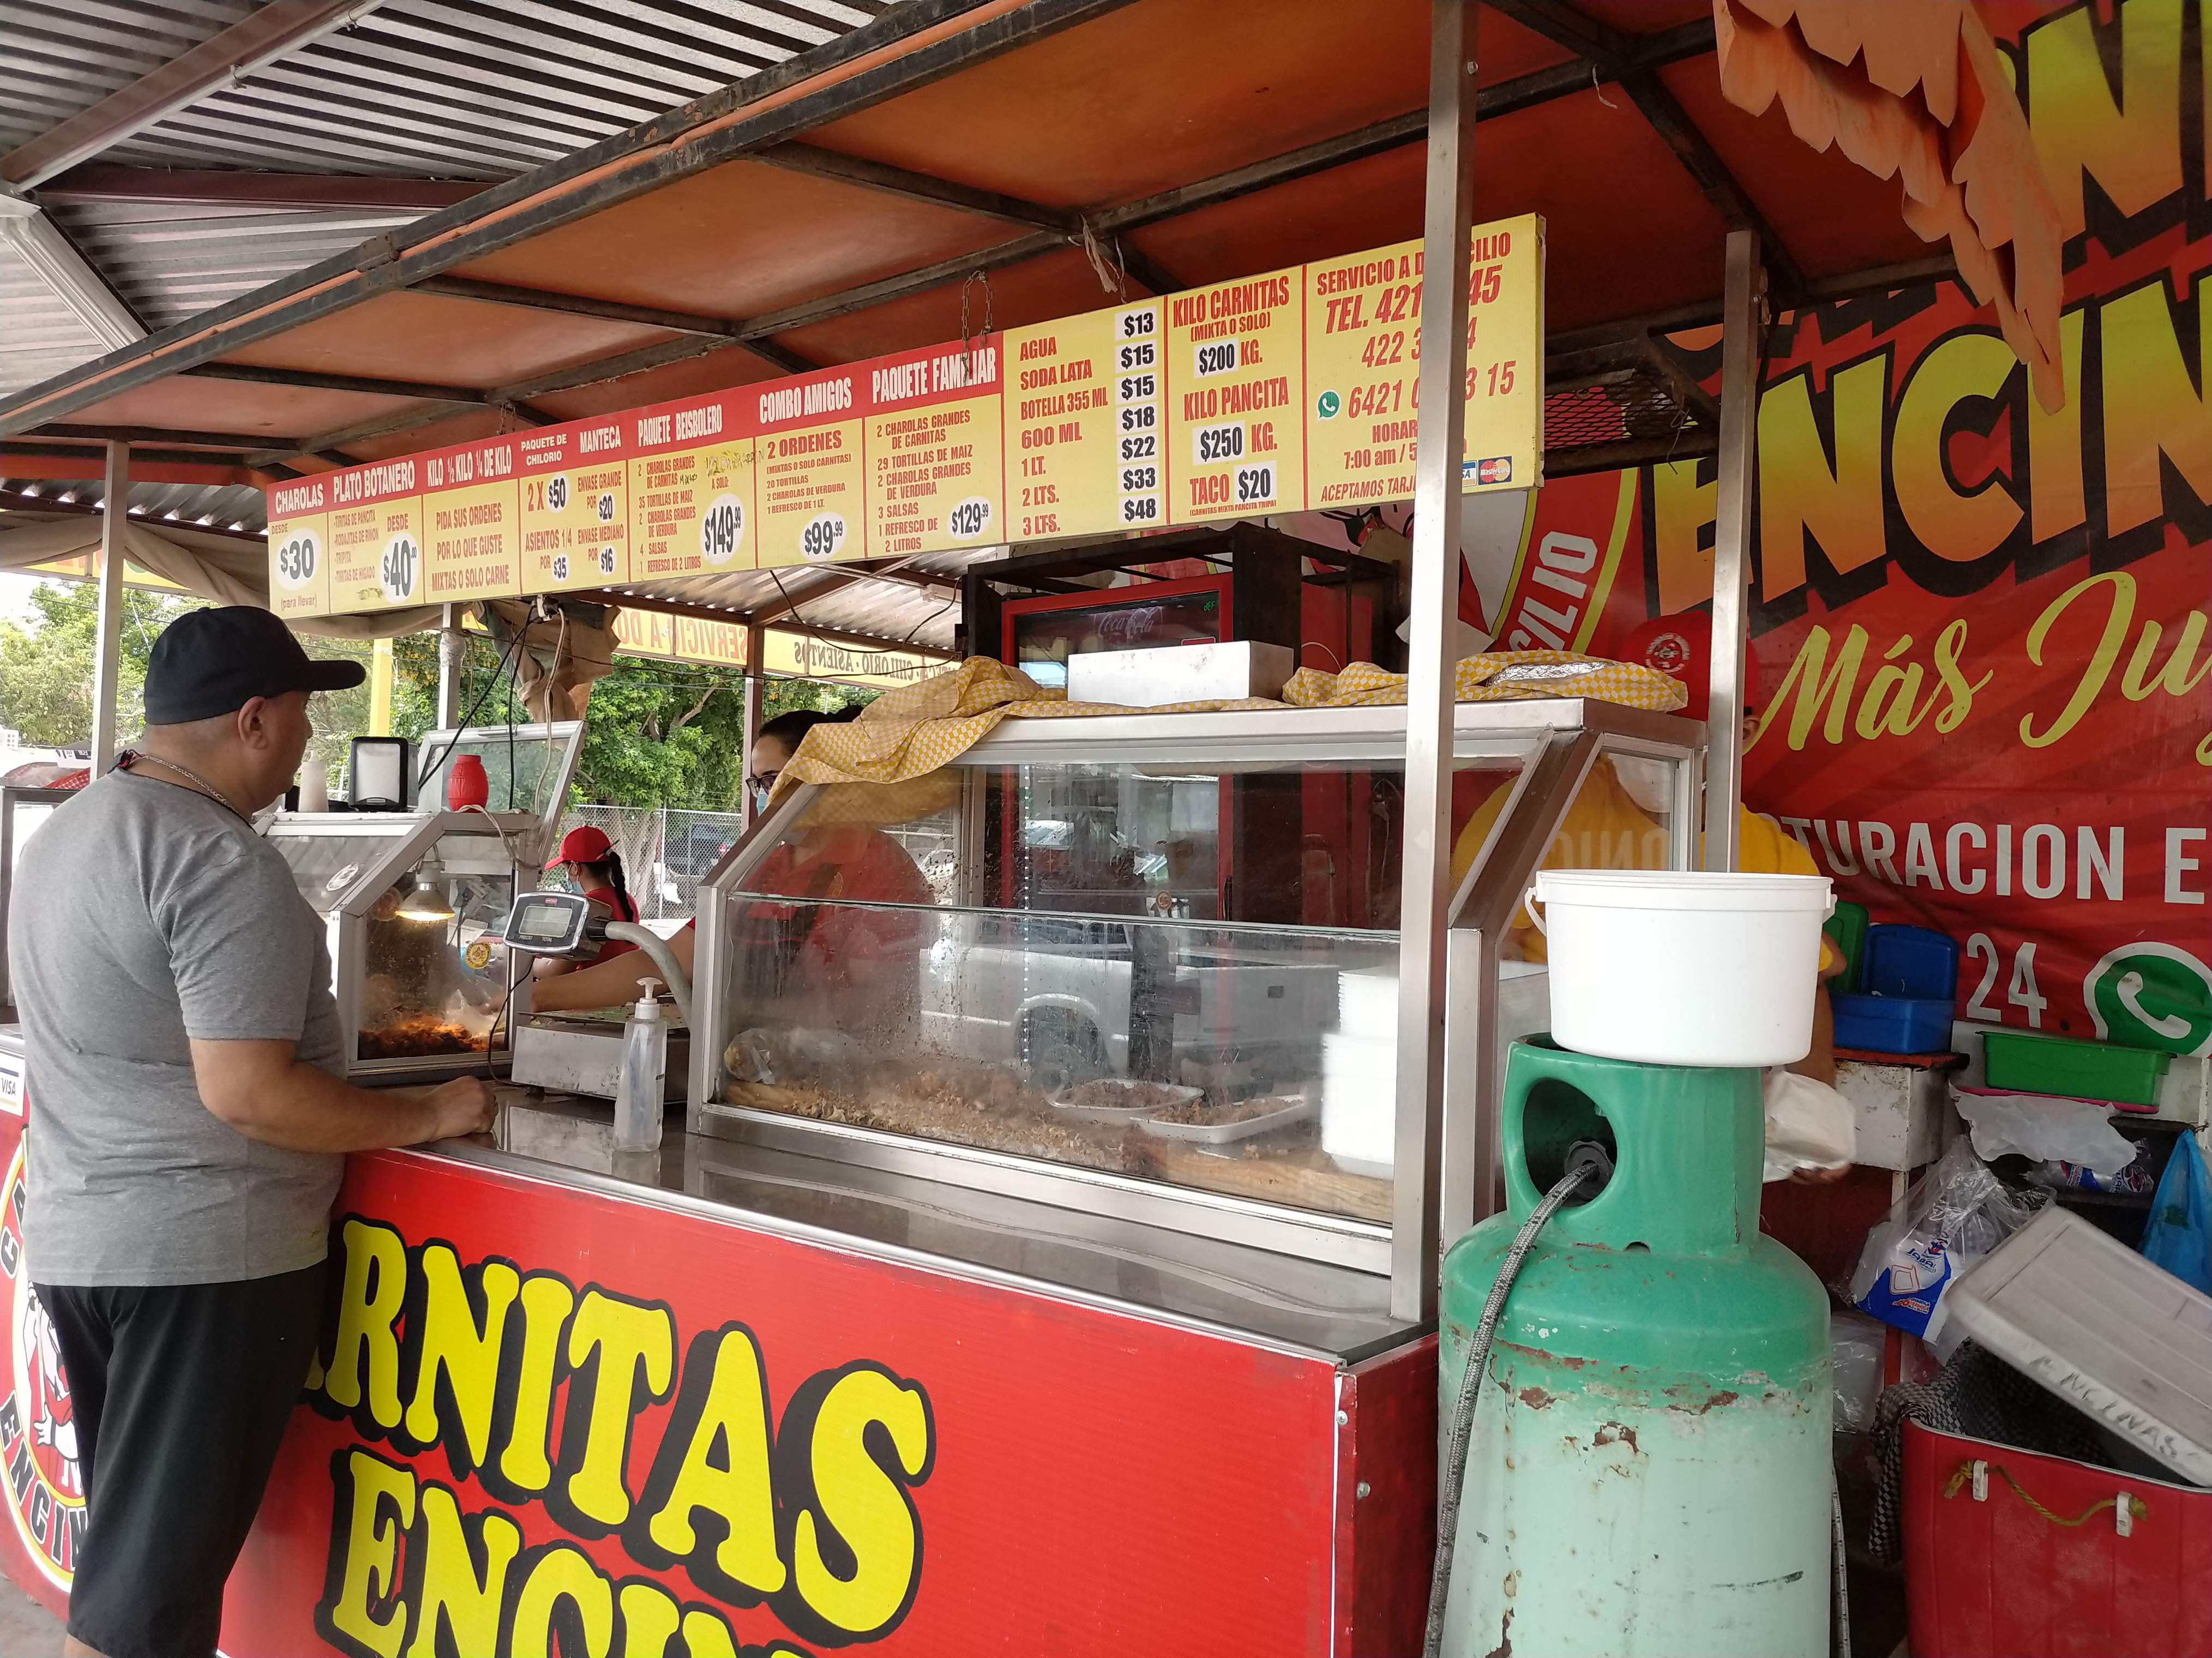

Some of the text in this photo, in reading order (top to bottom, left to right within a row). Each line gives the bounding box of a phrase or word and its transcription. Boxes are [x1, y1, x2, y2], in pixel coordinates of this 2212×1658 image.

[1317, 258, 1394, 296] SERVICIO
[1399, 255, 1410, 279] A
[1173, 276, 1289, 328] KILO CARNITAS
[1326, 295, 1369, 334] TEL.
[1375, 282, 1422, 324] 421
[1124, 312, 1153, 338] $13
[1019, 337, 1056, 362] AGUA
[1121, 344, 1153, 369] $15
[1199, 339, 1263, 376] $200 KG.
[1362, 331, 1404, 368] 422
[872, 347, 996, 404] PAQUETE FAMILIAR
[1020, 359, 1092, 391] SODA LATA
[1121, 375, 1155, 400] $15
[759, 377, 852, 424] COMBO AMIGOS
[1020, 387, 1108, 420] BOTELLA 355 ML
[1184, 376, 1289, 422] KILO PANCITA
[1348, 379, 1403, 419] 6421
[638, 404, 722, 447] PAQUETE BEISBOLERO
[877, 410, 970, 437] 2 CHAROLAS GRANDES
[1122, 406, 1155, 431] $18
[521, 434, 567, 452] PAQUETE DE
[580, 425, 621, 454] MANTECA
[767, 430, 842, 459] 2 ORDENES
[892, 428, 946, 449] DE CARNITAS
[1021, 422, 1082, 449] 600 ML
[1122, 436, 1155, 460] $22
[1200, 422, 1278, 462] $250 KG.
[428, 444, 512, 487] KILO KILO DE KILO
[526, 450, 562, 466] CHILORIO
[647, 460, 672, 475] CHAROLAS
[673, 455, 695, 470] GRANDES
[816, 453, 851, 467] CARNITAS)
[892, 444, 973, 468] TORTILLAS DE MAIZ
[1030, 456, 1046, 475] LT.
[1344, 448, 1396, 469] 7:00 am
[333, 462, 415, 503] PLATO BOTANERO
[578, 471, 621, 492] ENVASE GRANDE
[654, 473, 678, 488] CARNITAS
[717, 477, 729, 489] SOLO:
[776, 475, 809, 488] TORTILLAS
[877, 462, 971, 487] 2 CHAROLAS GRANDES
[1123, 467, 1156, 491] $33
[1189, 468, 1271, 506] TACO $20
[275, 483, 323, 514] CHAROLAS
[528, 478, 566, 512] 2 X $50
[647, 490, 693, 508] TORTILLAS MAIZ
[772, 483, 845, 501] CHAROLAS VERDURA
[887, 482, 937, 501] DE VERDURA
[1033, 485, 1060, 504] LTS.
[1321, 476, 1416, 502] ACEPTAMOS TARJ
[436, 502, 502, 531] PIDA SUS ORDENES
[587, 495, 613, 520] POR $20
[647, 506, 696, 524] CHAROLAS GRANDES
[772, 501, 803, 513] REFRESCO
[887, 502, 919, 518] SALSAS
[1124, 498, 1156, 521] $48
[272, 524, 288, 534] DESDE
[387, 513, 408, 532] DESDE
[578, 524, 623, 544] ENVASE MEDIANO
[656, 522, 677, 537] VERDURA
[885, 518, 938, 536] REFRESCO DE
[1034, 514, 1061, 534] LTS.
[437, 534, 502, 561] POR LO QUE GUSTE
[525, 528, 560, 552] ASIENTOS
[648, 542, 667, 555] SALSAS
[894, 537, 922, 551] LITROS
[280, 539, 314, 580] $30
[540, 555, 566, 579] POR $35
[588, 548, 613, 573] POR $16
[648, 556, 701, 573] REFRESCO LITROS
[432, 564, 509, 591] MIXTAS SOLO CARNE
[1742, 571, 2212, 766] Más Ju
[1760, 813, 2125, 902] TURACION
[1966, 932, 2048, 1029] 24
[1, 1078, 16, 1096] VISA
[303, 1220, 928, 1633] RNITAS
